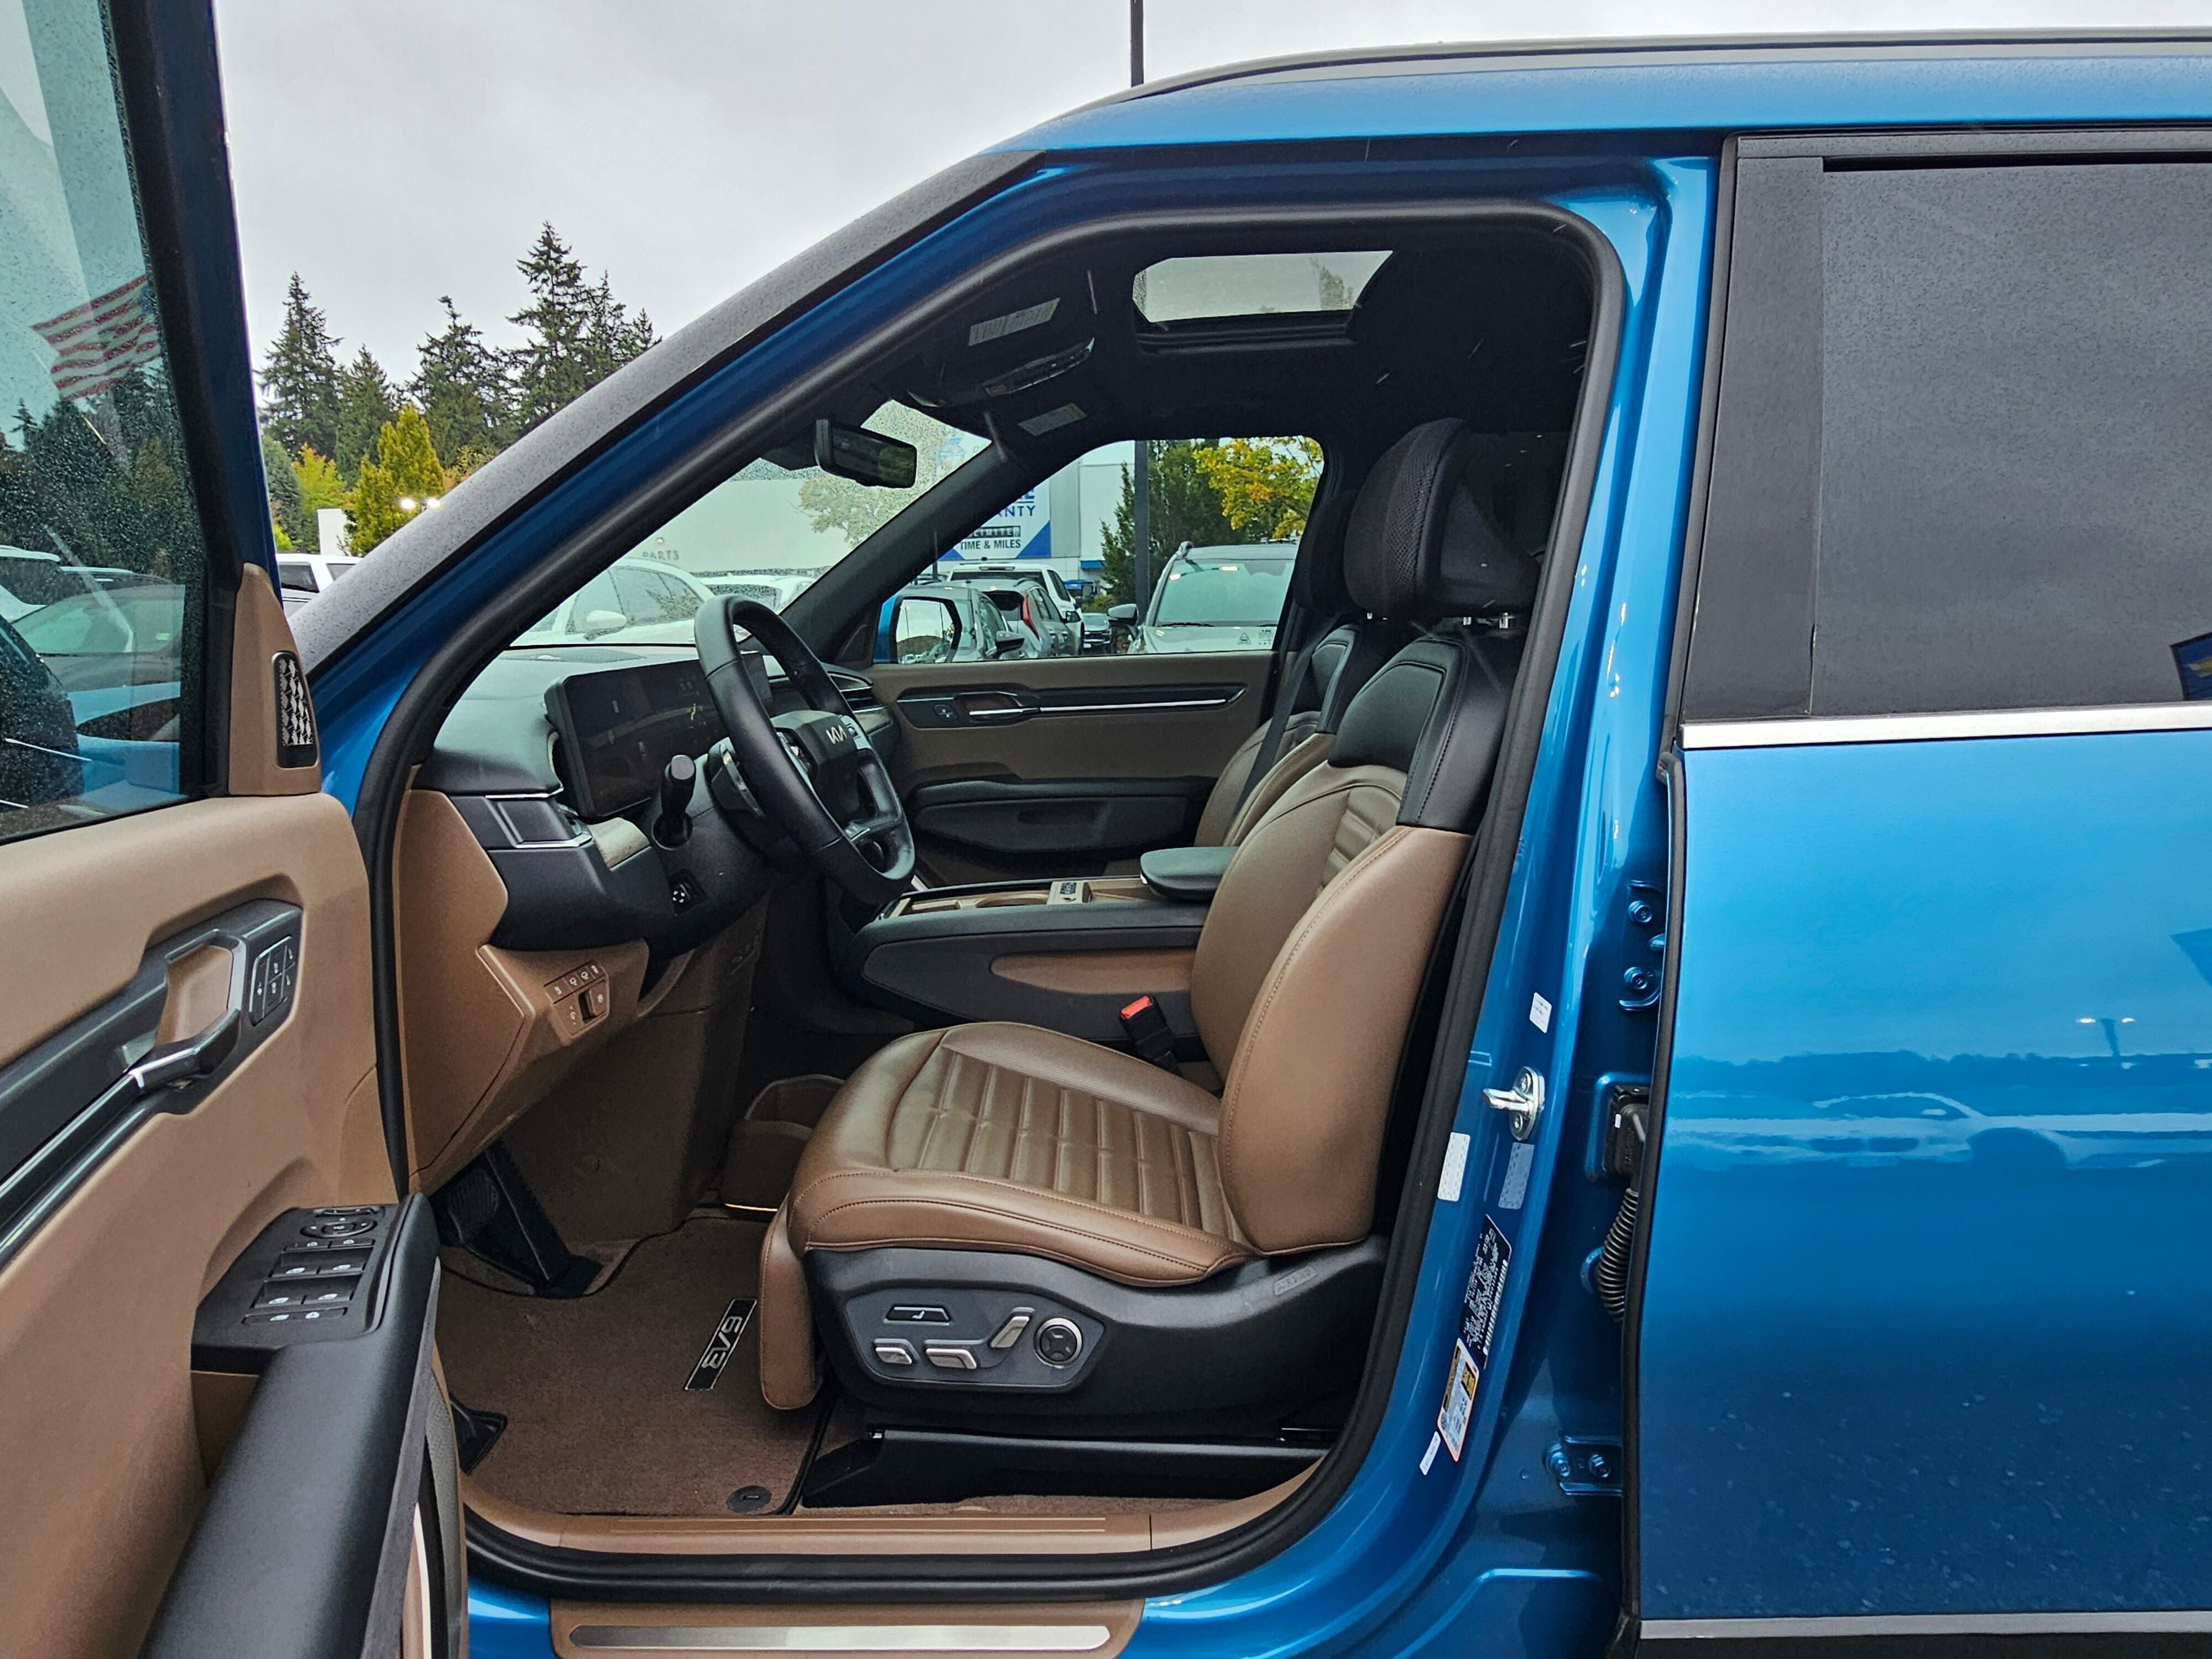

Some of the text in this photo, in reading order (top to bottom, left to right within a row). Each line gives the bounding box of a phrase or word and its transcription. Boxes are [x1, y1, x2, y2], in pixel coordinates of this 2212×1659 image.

[984, 540, 990, 549] &
[994, 539, 1021, 549] MILES
[701, 1316, 743, 1369] EV9
